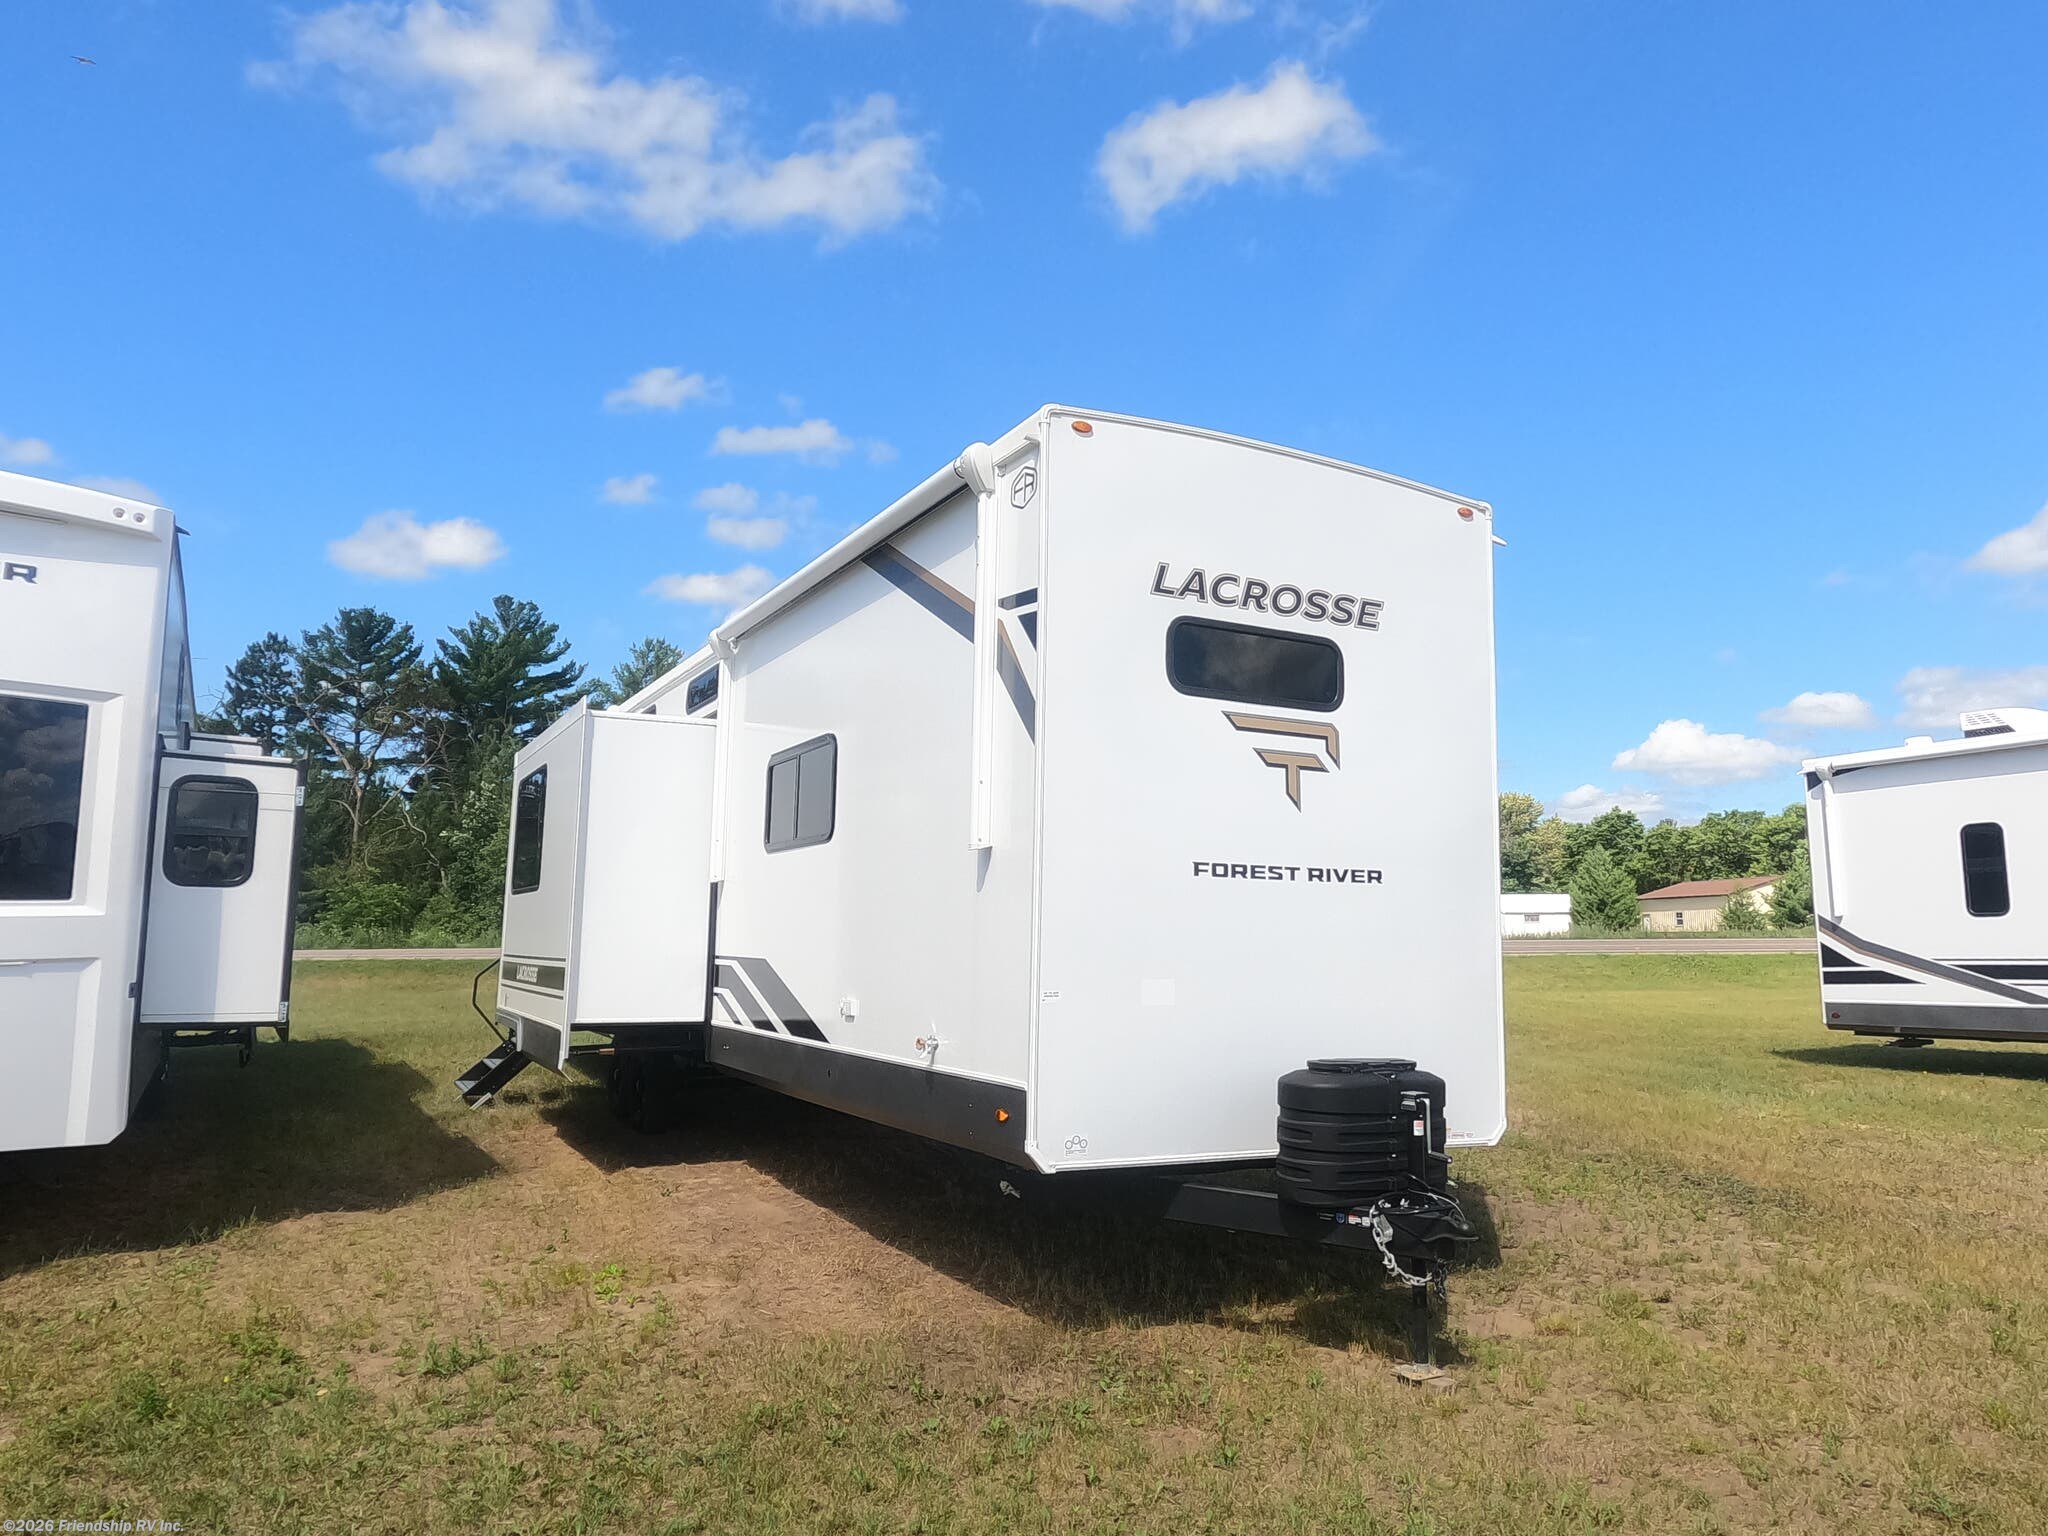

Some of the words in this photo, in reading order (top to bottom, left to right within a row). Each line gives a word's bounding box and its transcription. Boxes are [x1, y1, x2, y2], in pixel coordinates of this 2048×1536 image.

[1150, 562, 1384, 631] LACROSSE
[1192, 861, 1300, 882] FOREST
[1307, 867, 1384, 884] RIVER
